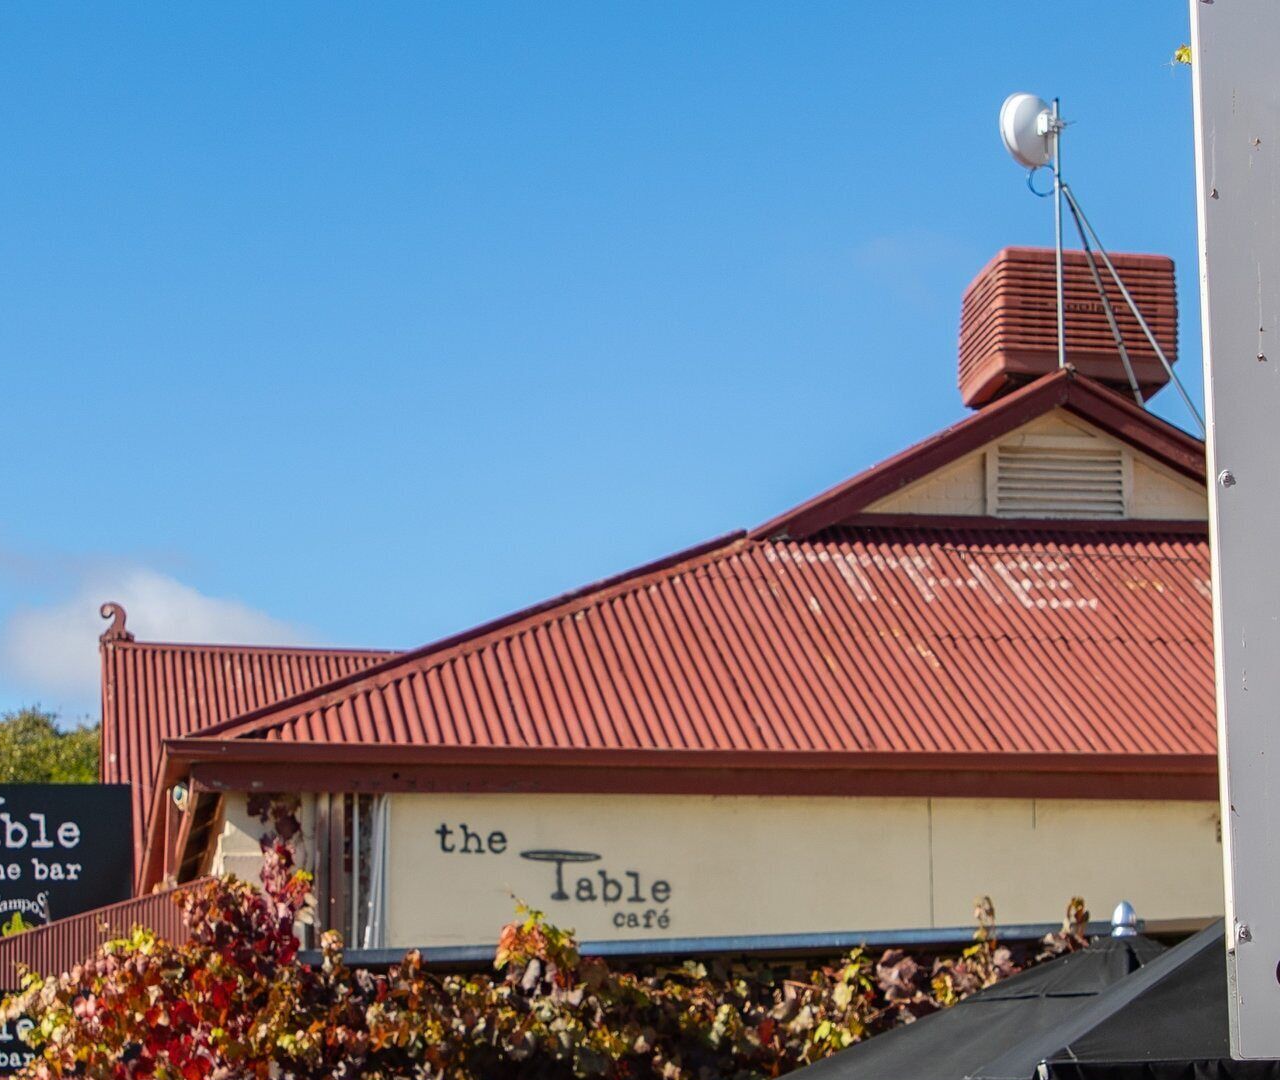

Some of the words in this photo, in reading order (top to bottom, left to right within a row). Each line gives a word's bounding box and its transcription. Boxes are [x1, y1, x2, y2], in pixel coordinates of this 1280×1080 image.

[435, 823, 508, 854] the
[31, 857, 82, 880] bar
[520, 850, 672, 902] Table
[613, 908, 671, 930] café
